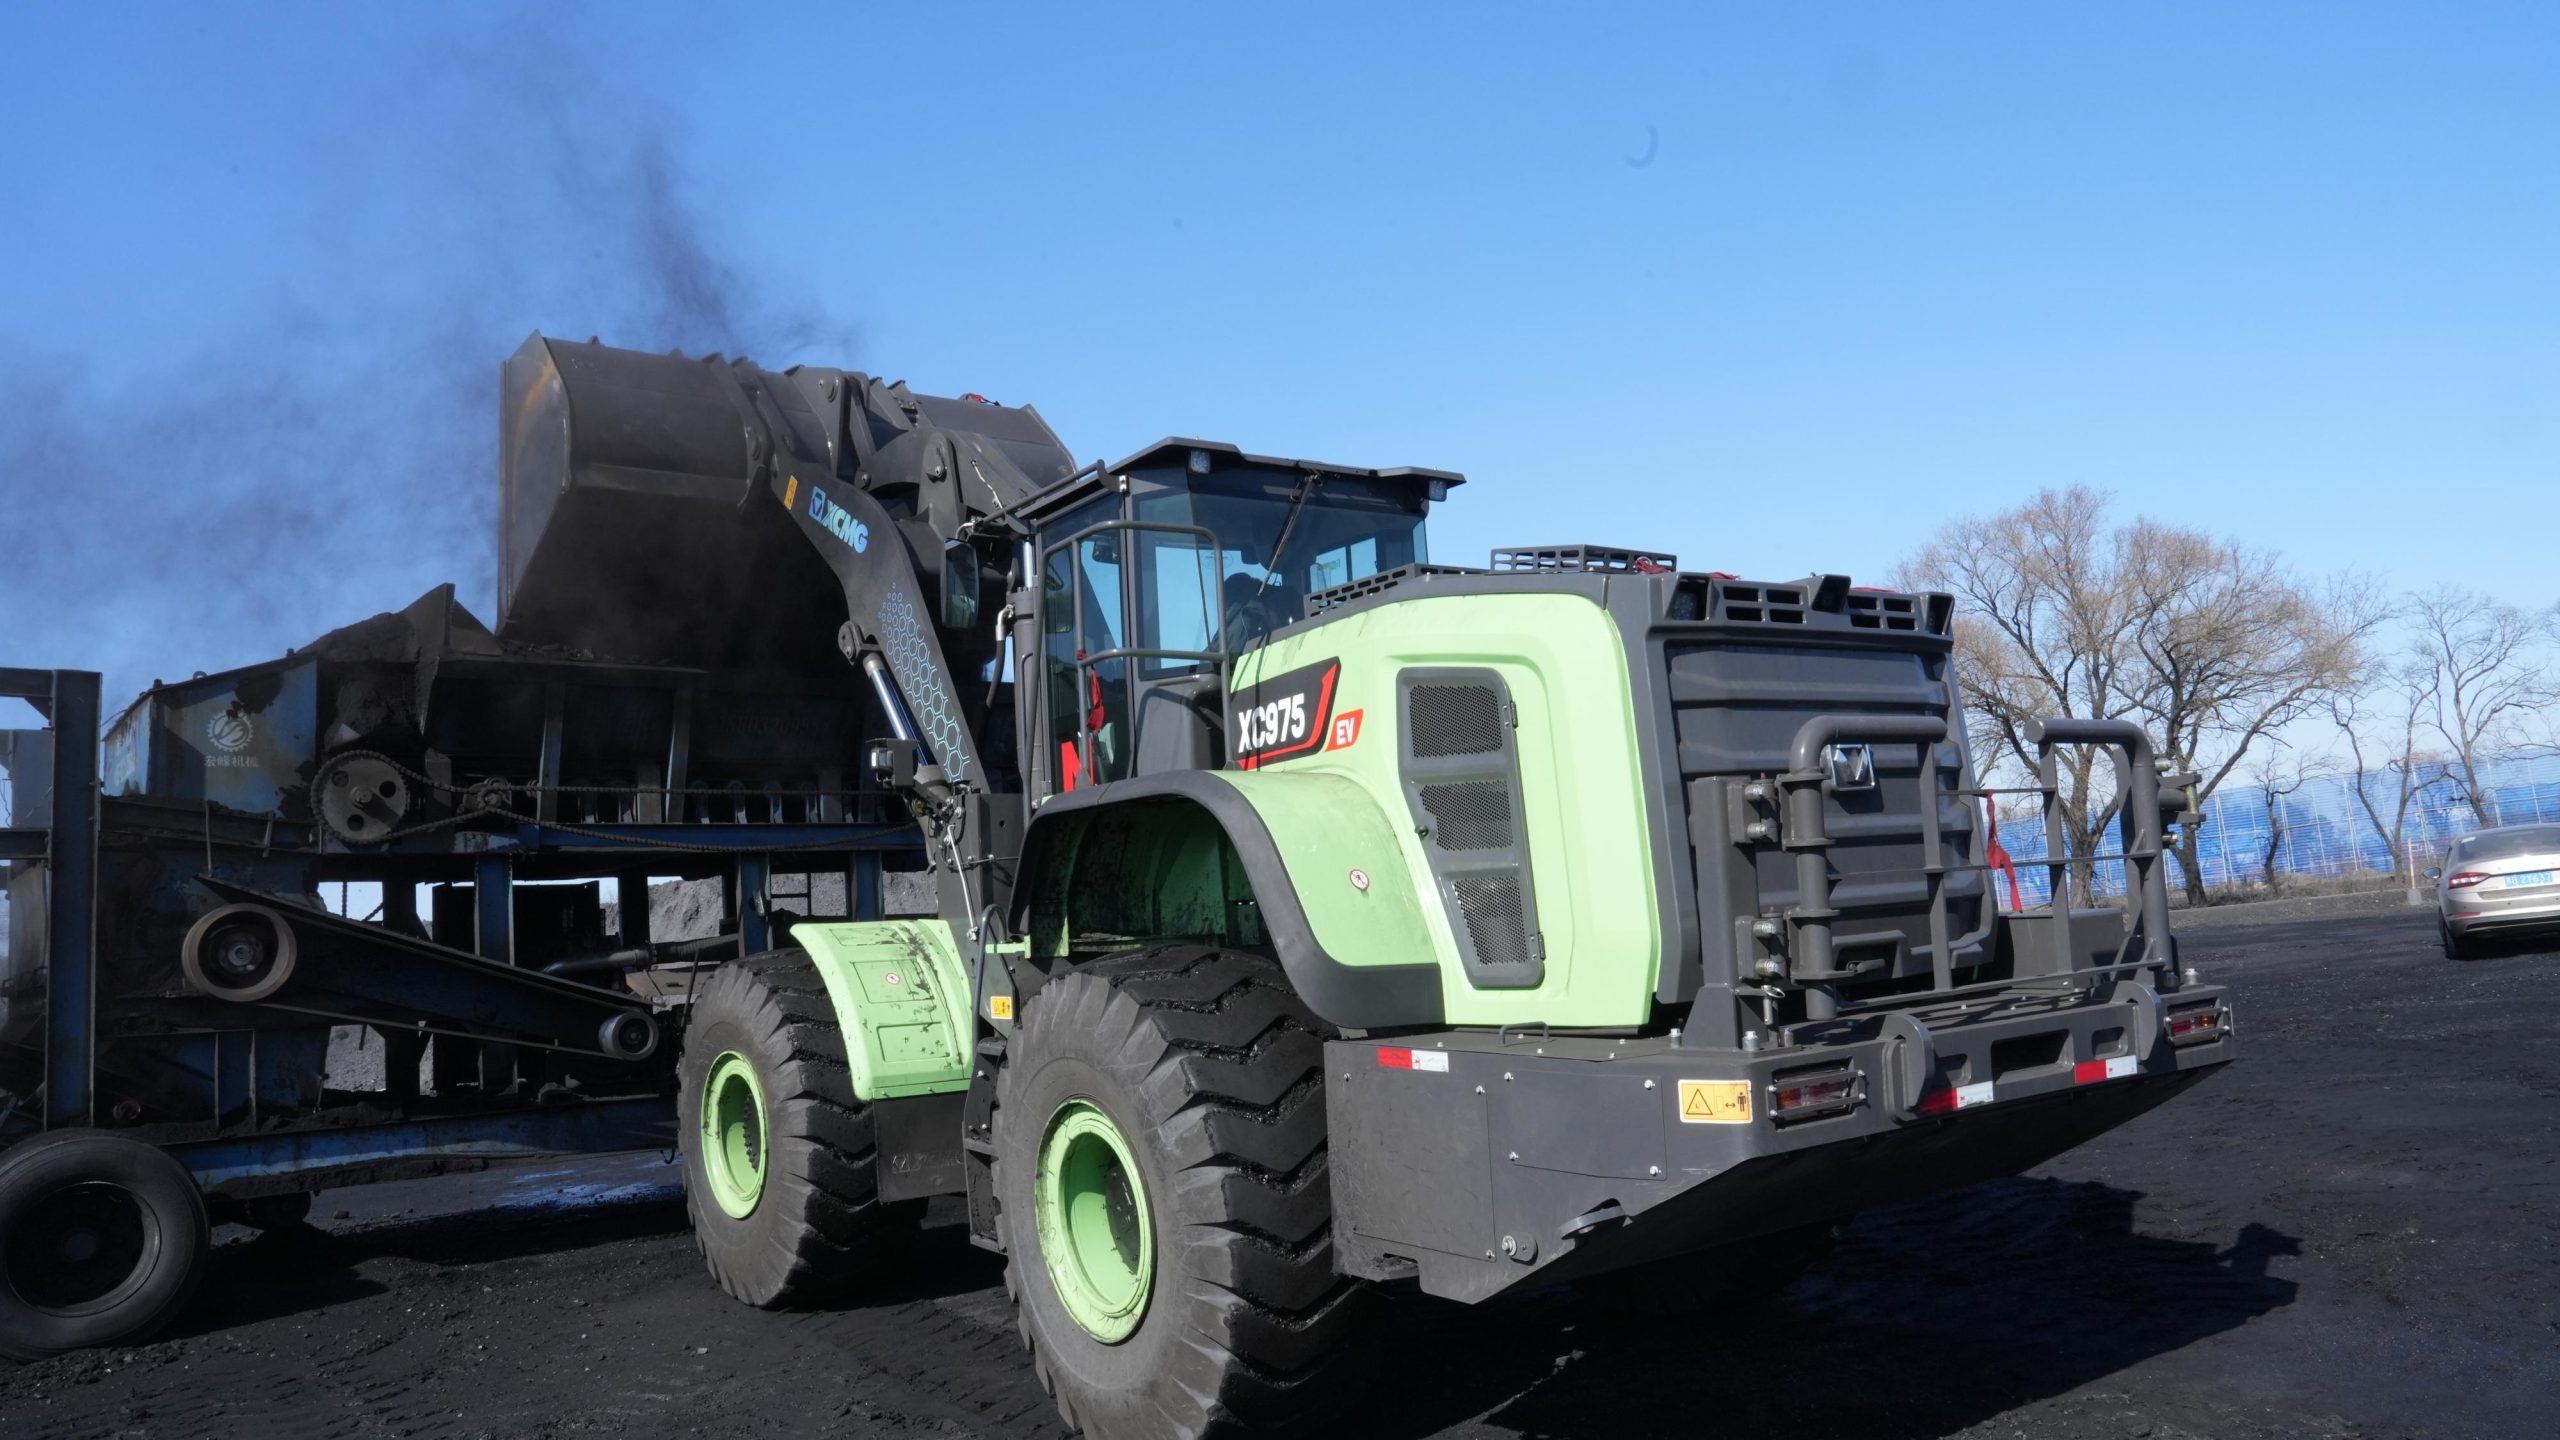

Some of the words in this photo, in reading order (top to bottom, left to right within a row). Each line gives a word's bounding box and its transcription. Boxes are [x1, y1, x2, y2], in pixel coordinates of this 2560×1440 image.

[822, 499, 869, 554] XCMG
[1238, 693, 1305, 753] XC975
[1336, 717, 1355, 745] EV
